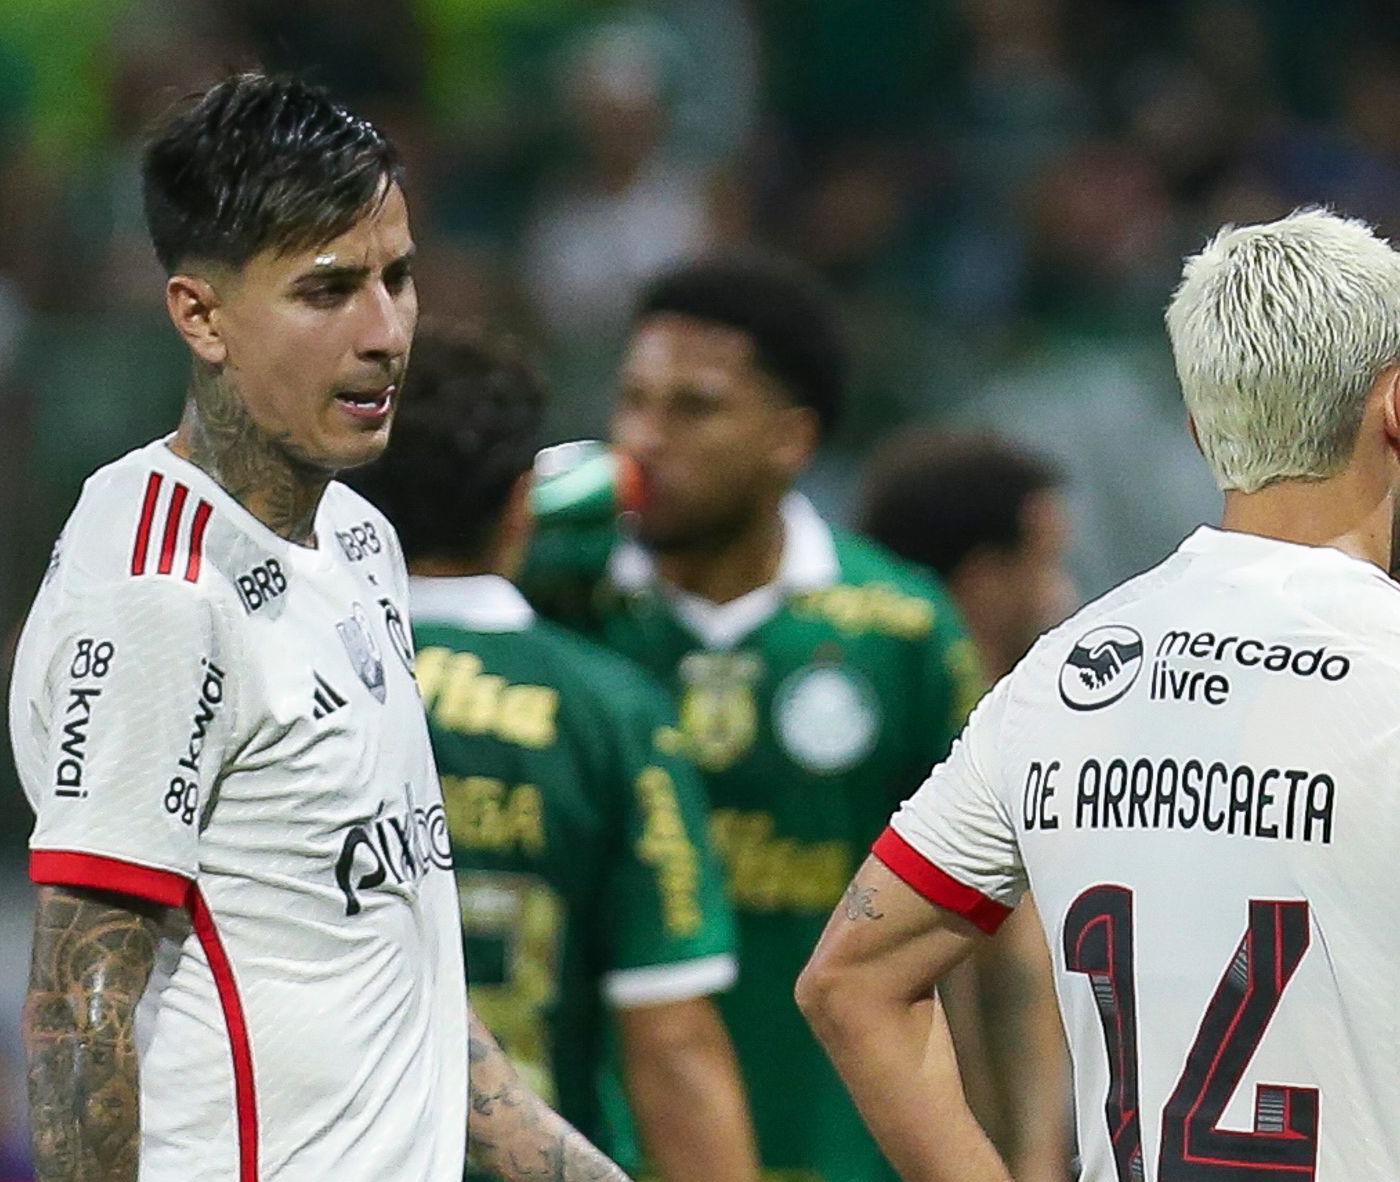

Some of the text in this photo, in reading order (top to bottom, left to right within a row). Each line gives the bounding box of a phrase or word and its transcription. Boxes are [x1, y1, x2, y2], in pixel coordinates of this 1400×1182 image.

[236, 558, 287, 612] BRB
[1150, 660, 1230, 706] livre
[1156, 631, 1350, 682] mercado
[55, 688, 102, 798] kwai
[179, 657, 225, 773] kwai
[1023, 757, 1335, 844] DE ARRASCAETA
